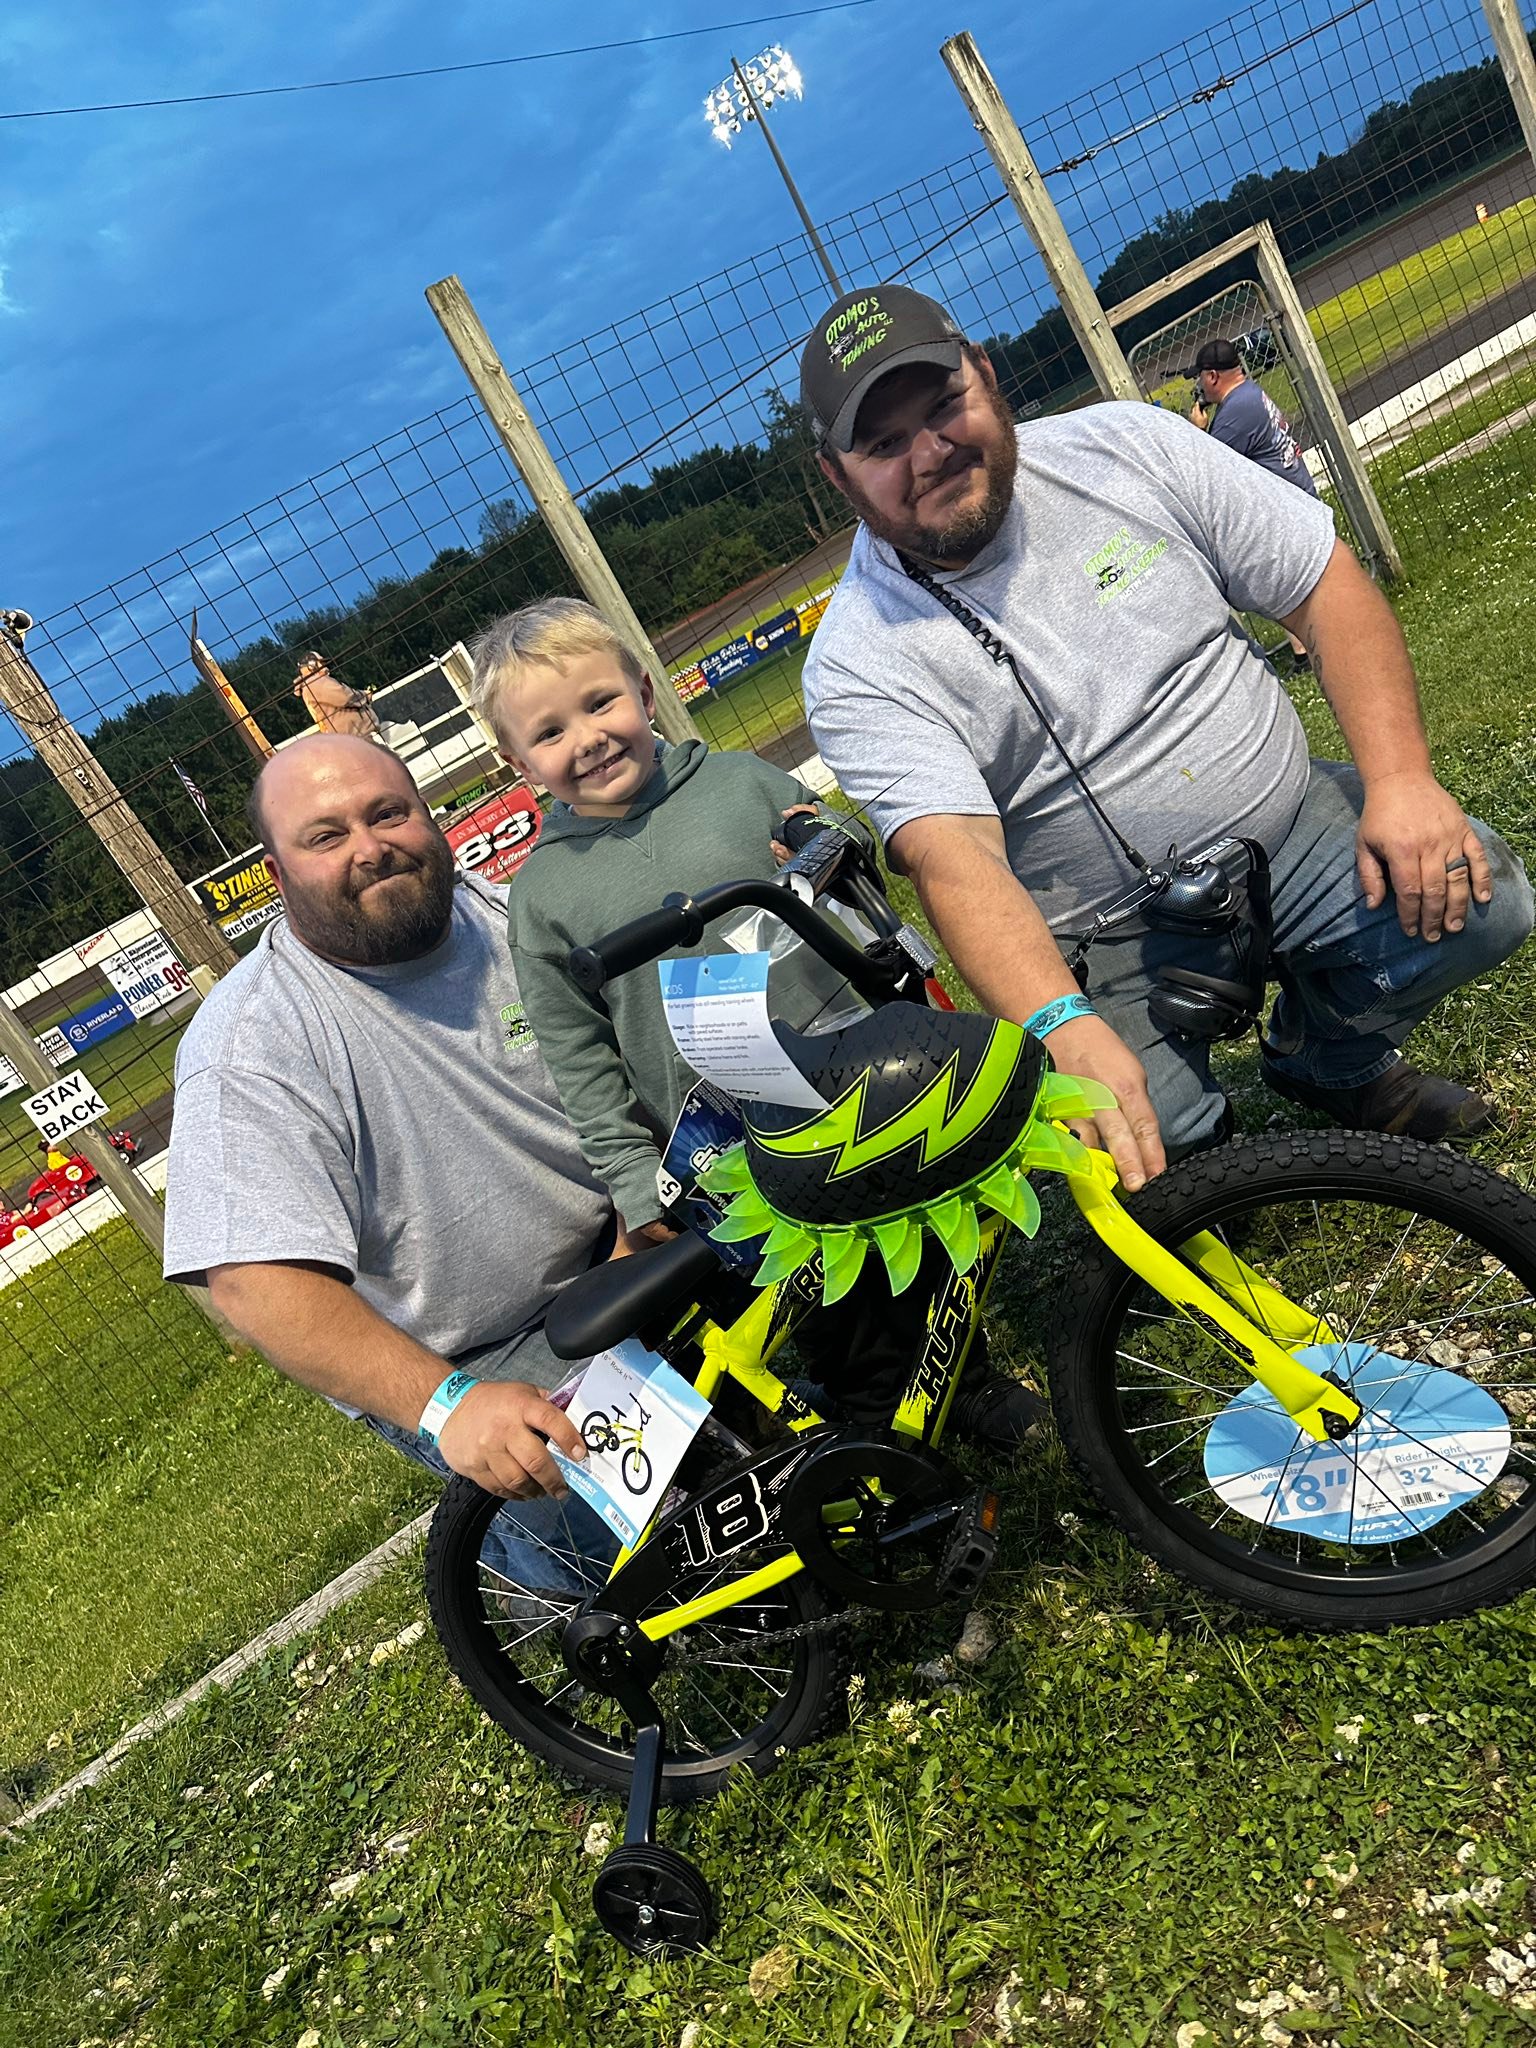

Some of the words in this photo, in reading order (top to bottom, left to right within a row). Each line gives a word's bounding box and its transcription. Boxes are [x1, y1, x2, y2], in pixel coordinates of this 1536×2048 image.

[825, 296, 880, 345] OTOMO'S
[855, 311, 888, 335] AUTO
[841, 328, 887, 372] TOWING
[1083, 526, 1131, 577] OTOMO'S
[456, 783, 488, 807] OTOMO'S
[456, 831, 466, 840] IN
[467, 813, 498, 834] MEMORY
[454, 810, 533, 872] 83
[225, 911, 265, 937] VICTORY
[122, 973, 165, 1004] POWER
[86, 1004, 123, 1029] RIVERLAND
[31, 1076, 83, 1116] STAY
[42, 1094, 105, 1140] BACK
[612, 1344, 628, 1361] IDS
[610, 1360, 624, 1376] Rock
[1395, 1451, 1426, 1464] Rider
[1427, 1445, 1463, 1460] Height
[1249, 1468, 1284, 1482] Wheel
[1284, 1466, 1305, 1477] Size
[1399, 1465, 1440, 1486] 3'2"
[1259, 1468, 1347, 1516] 18"
[674, 1472, 770, 1567] 18
[1352, 1519, 1406, 1534] HUFFY
